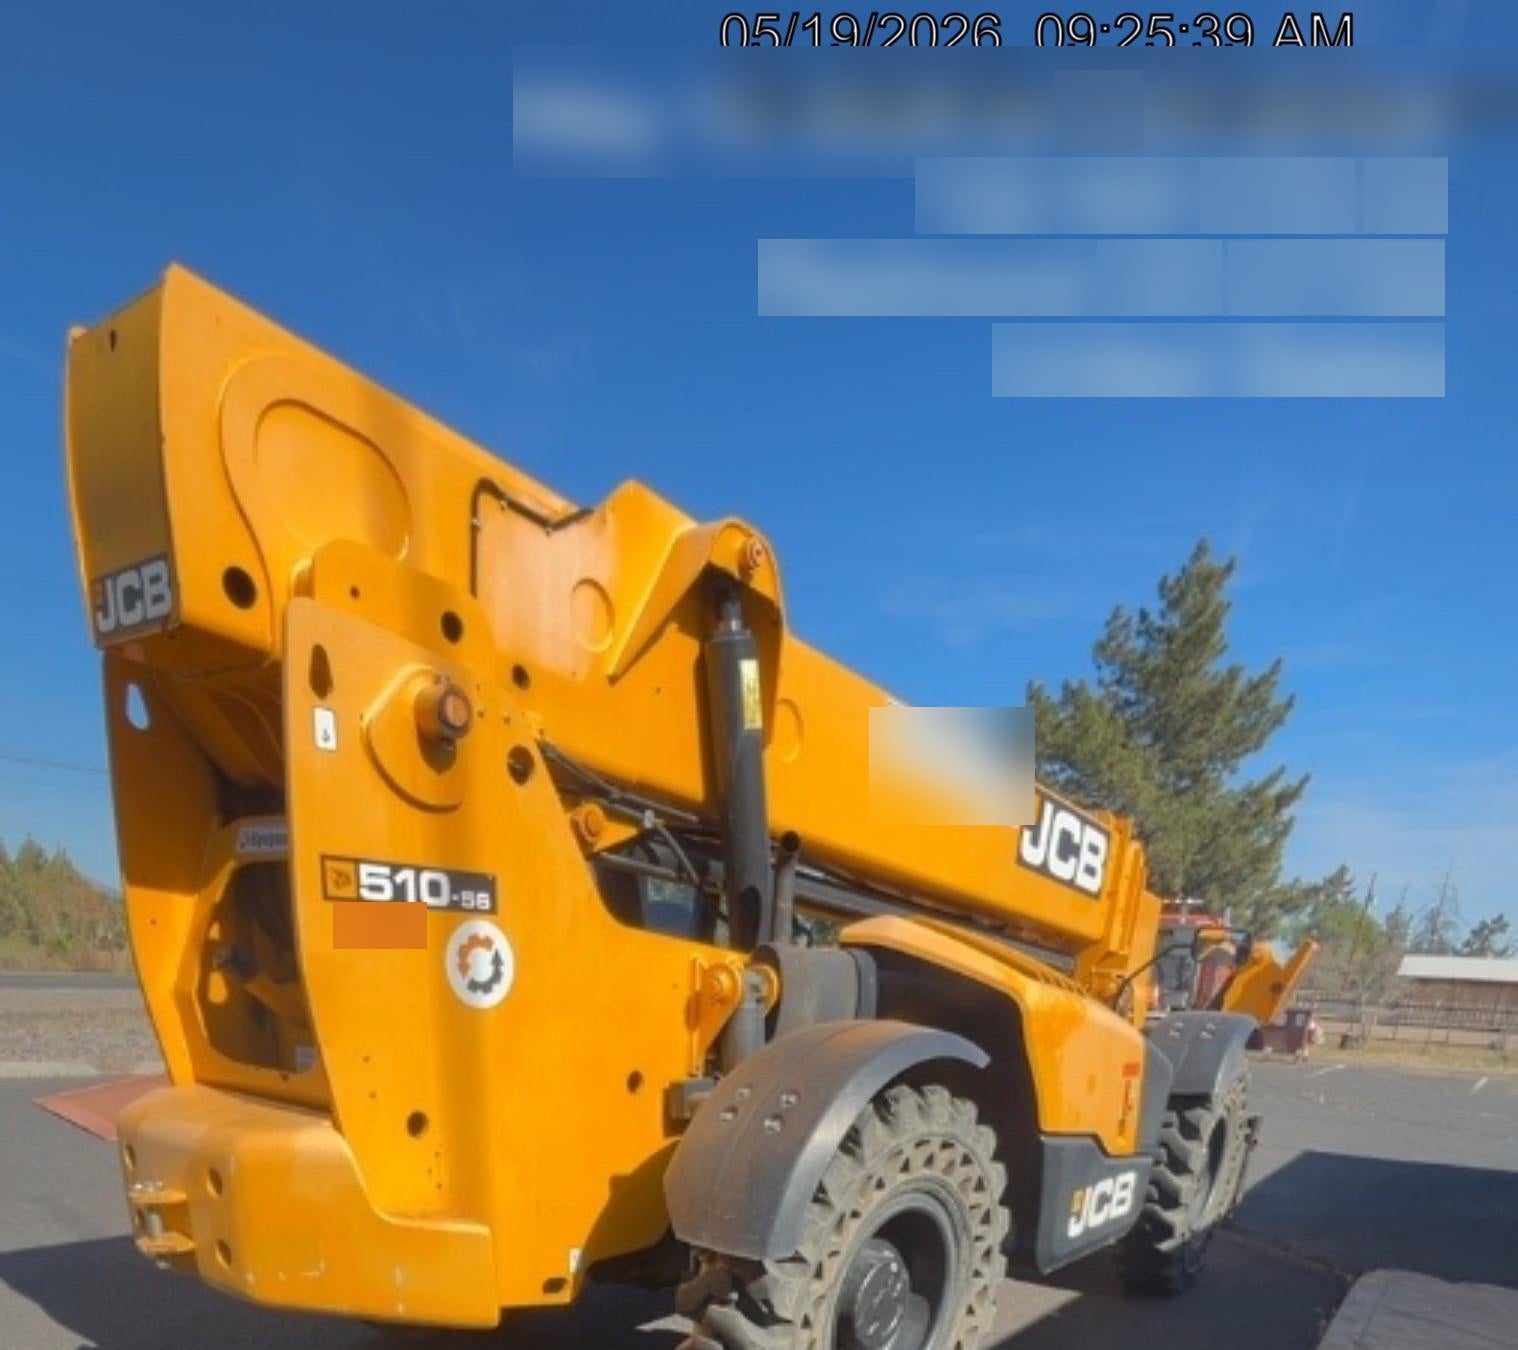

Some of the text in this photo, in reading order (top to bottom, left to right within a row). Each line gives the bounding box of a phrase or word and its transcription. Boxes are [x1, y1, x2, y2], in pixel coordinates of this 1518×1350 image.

[97, 560, 172, 633] JCB
[1020, 800, 1108, 892] JCB
[1067, 1171, 1137, 1238] JCB
